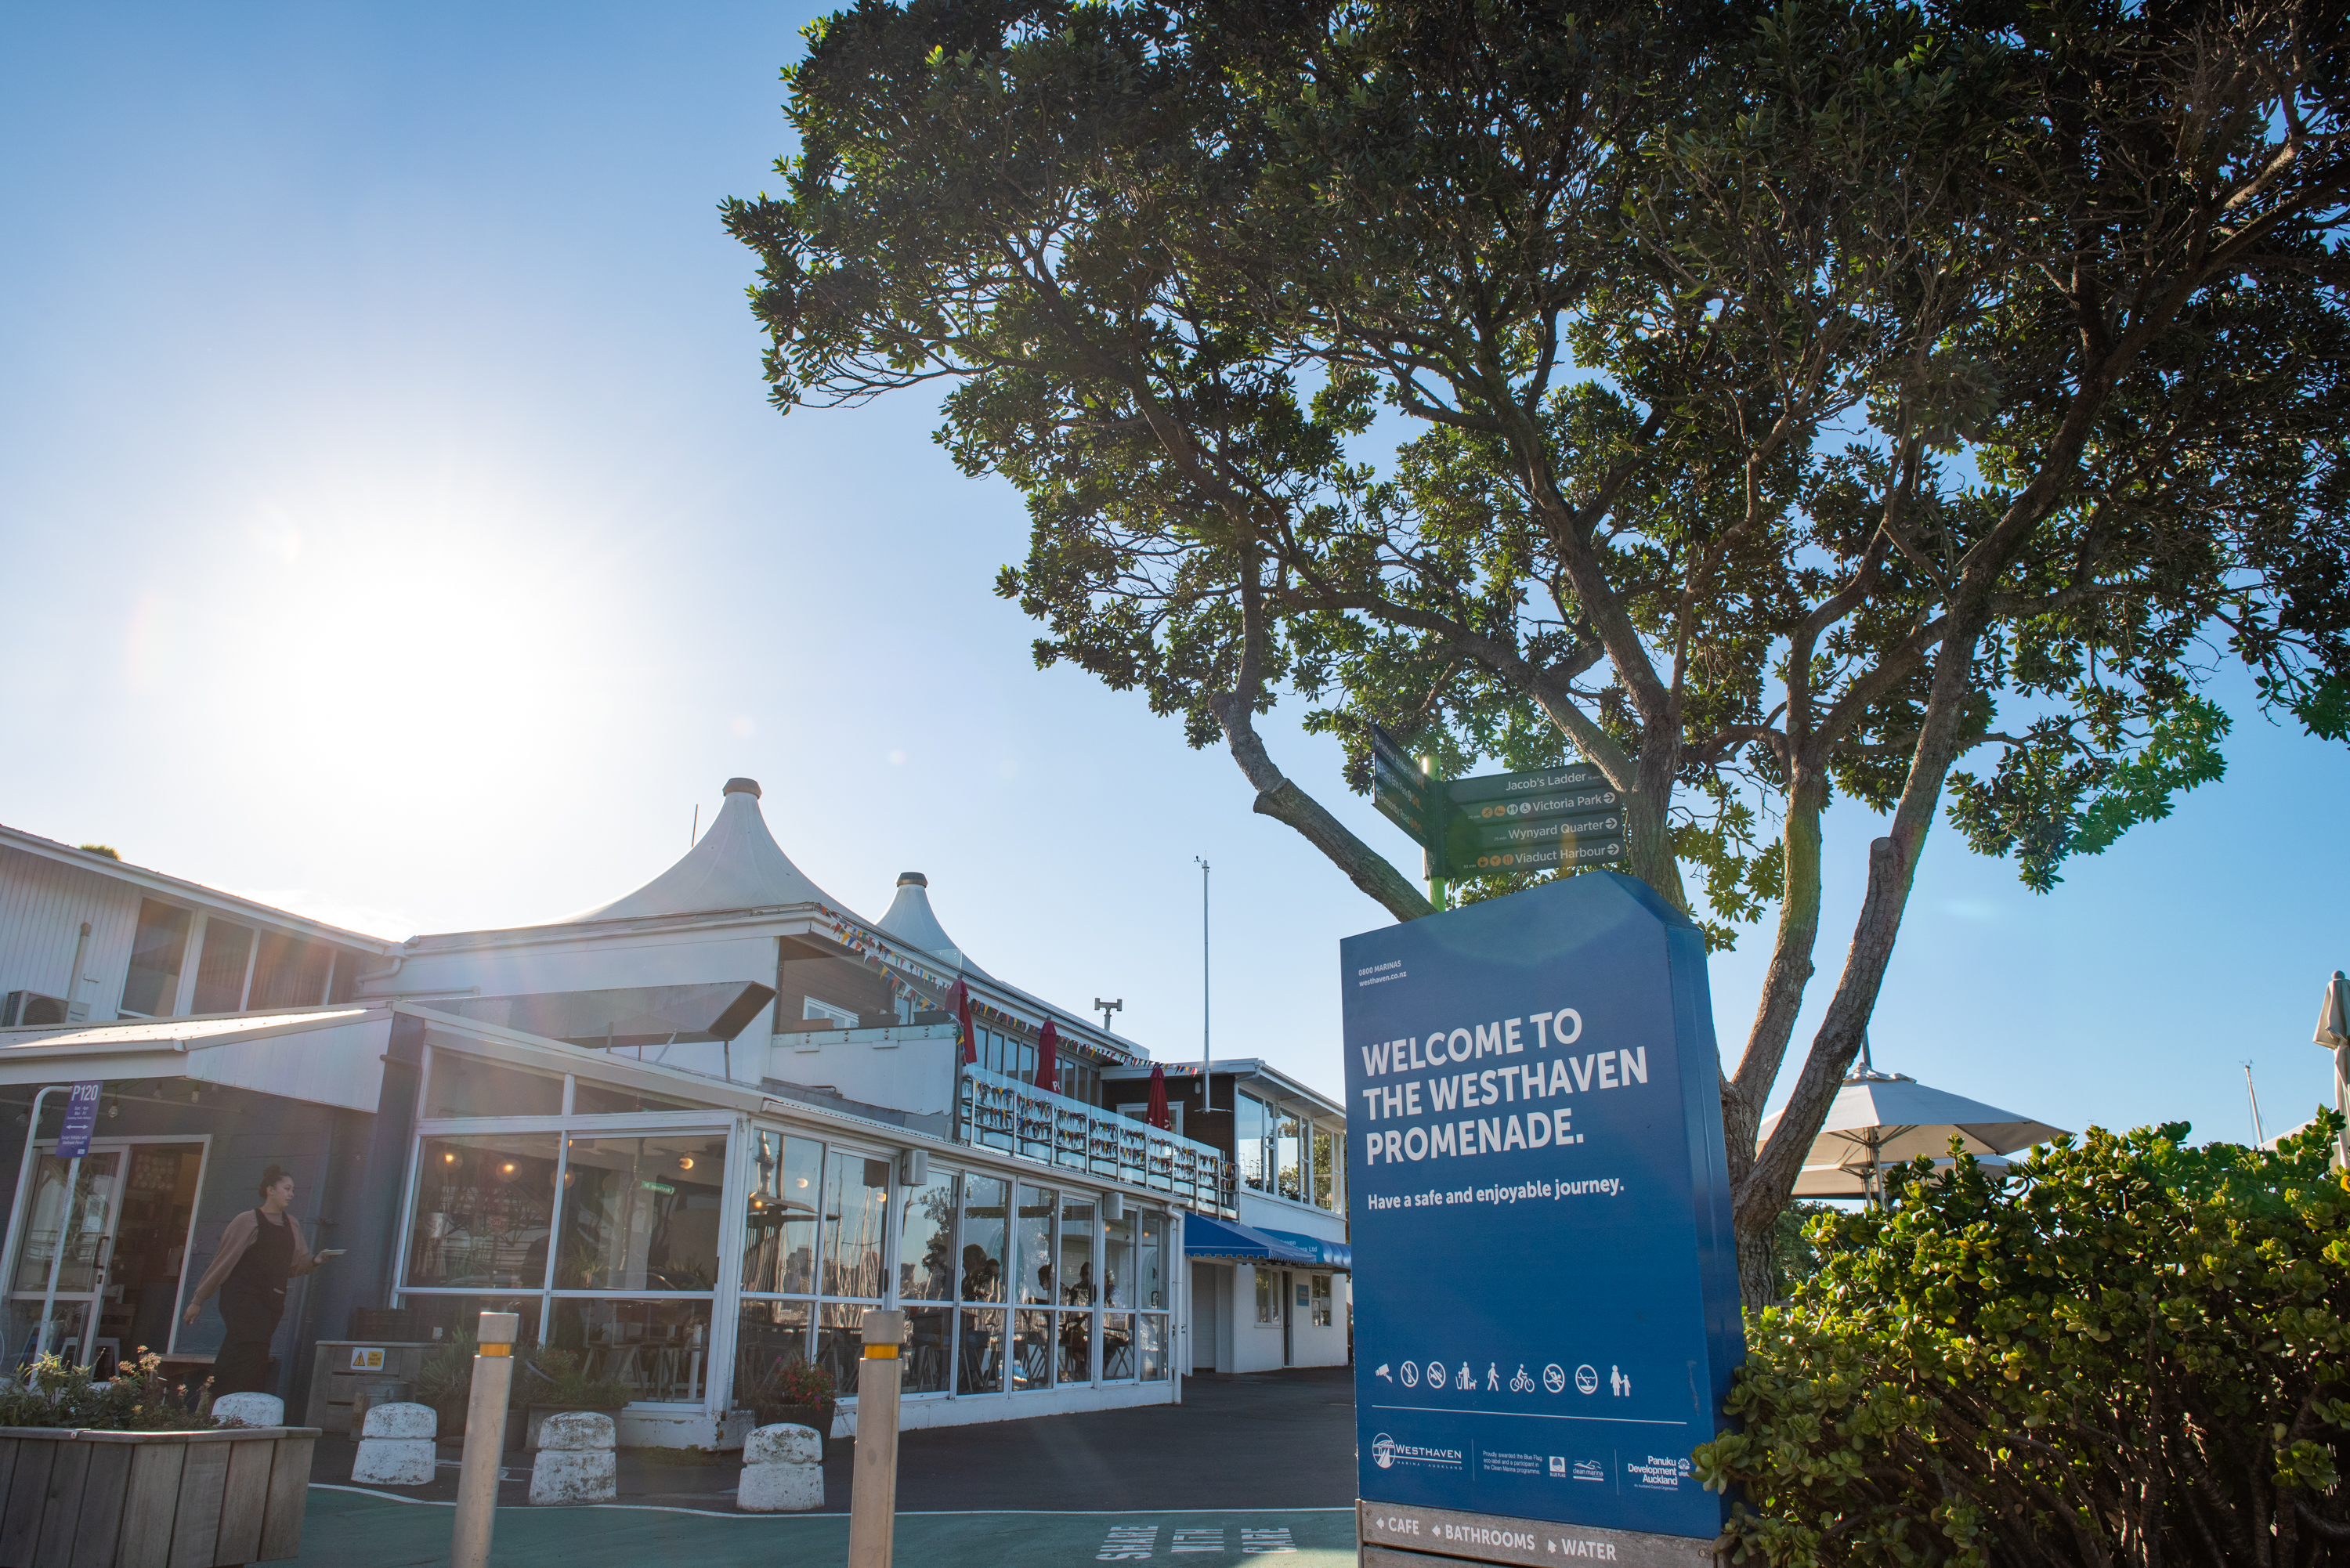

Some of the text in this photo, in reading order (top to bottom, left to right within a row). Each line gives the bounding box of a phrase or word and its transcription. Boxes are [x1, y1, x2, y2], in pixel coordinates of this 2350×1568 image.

[1379, 739, 1416, 782] Harbour Bridge Park
[1381, 765, 1391, 783] Point
[1399, 783, 1408, 797] Park
[1506, 778, 1545, 791] Jacob's
[1548, 773, 1586, 786] Ladder
[1380, 792, 1410, 824] Ponsonby Road
[1533, 798, 1574, 811] Victoria
[1578, 793, 1602, 807] Park
[1509, 825, 1557, 840] Wynyard
[1560, 822, 1603, 833] Quarter
[1515, 851, 1556, 864] Viaduct
[1560, 846, 1605, 859] Harbour
[1358, 960, 1401, 976] 0800 MARINAS
[1359, 970, 1407, 987] westhaven.co.nz
[1361, 1007, 1582, 1077] WELCOME TO
[71, 1085, 99, 1101] P120
[1363, 1046, 1647, 1121] THE WESTHAVEN
[1366, 1107, 1584, 1165] PROMENADE.
[1368, 1176, 1625, 1210] Have a safe and enjoyable journey.
[1395, 1443, 1462, 1459] WESTHAVEN
[1648, 1455, 1676, 1466] Panuku
[1628, 1463, 1677, 1476] Development
[1643, 1473, 1678, 1485] Auckland
[1095, 1526, 1159, 1560] SHARE
[1171, 1529, 1224, 1552] WITH
[1240, 1527, 1298, 1554] CARE
[1388, 1516, 1617, 1561] CAFE BATHROOMS WATER
